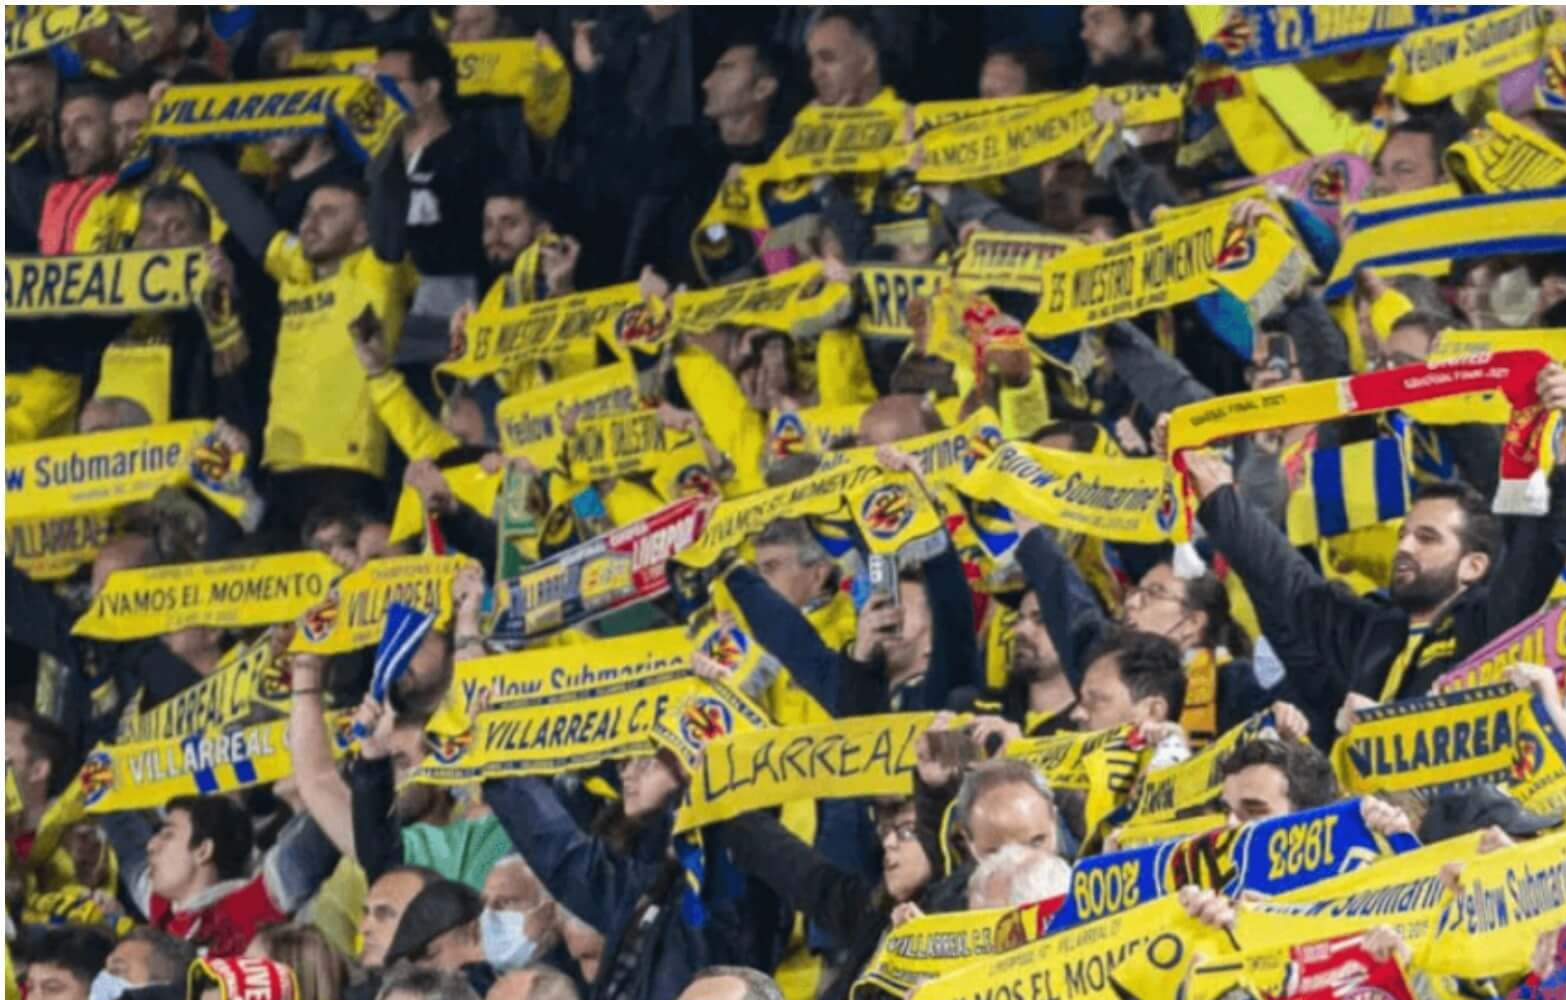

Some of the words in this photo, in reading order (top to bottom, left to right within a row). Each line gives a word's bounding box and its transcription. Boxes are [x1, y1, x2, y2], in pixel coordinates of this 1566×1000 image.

[34, 441, 182, 488] Submarine
[210, 572, 324, 602] MOMENTO
[485, 707, 619, 751] VILLARREAL
[128, 727, 275, 783] VILLARREAL
